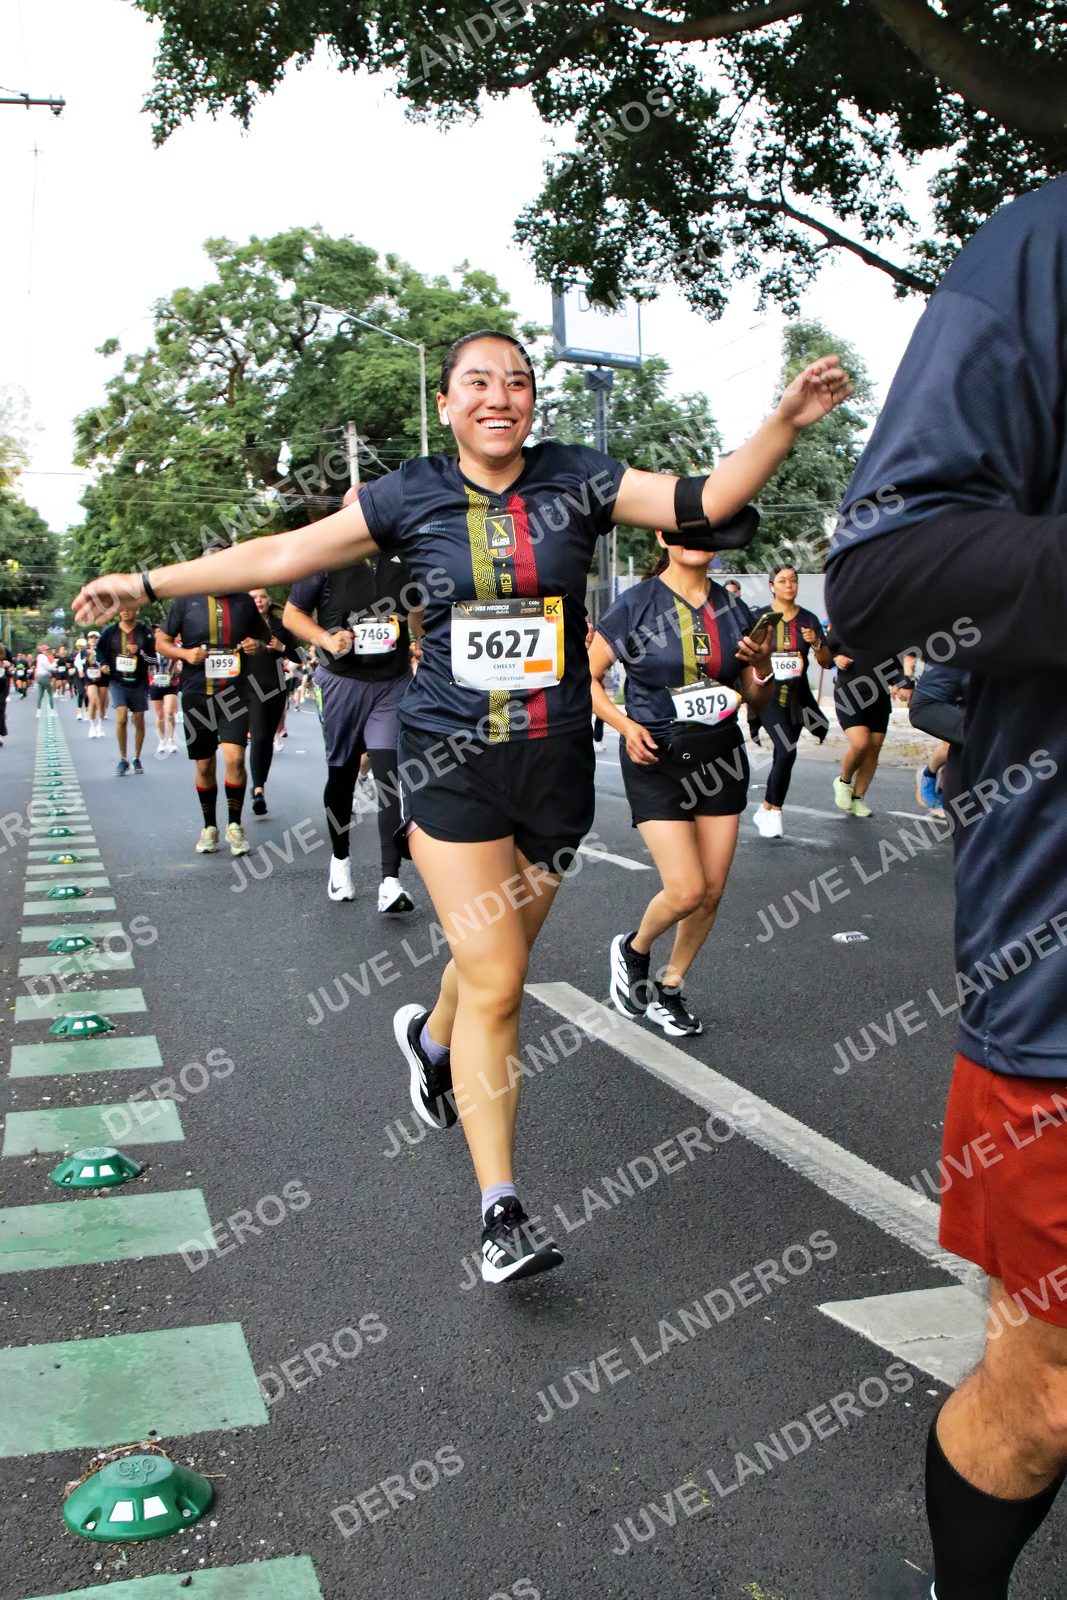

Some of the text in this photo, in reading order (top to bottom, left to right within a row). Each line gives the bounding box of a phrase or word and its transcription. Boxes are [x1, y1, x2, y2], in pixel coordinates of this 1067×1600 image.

[361, 628, 390, 640] 7465
[467, 628, 540, 660] 5627
[211, 658, 233, 668] 1959
[775, 660, 797, 670] 1668
[685, 693, 728, 718] 3879
